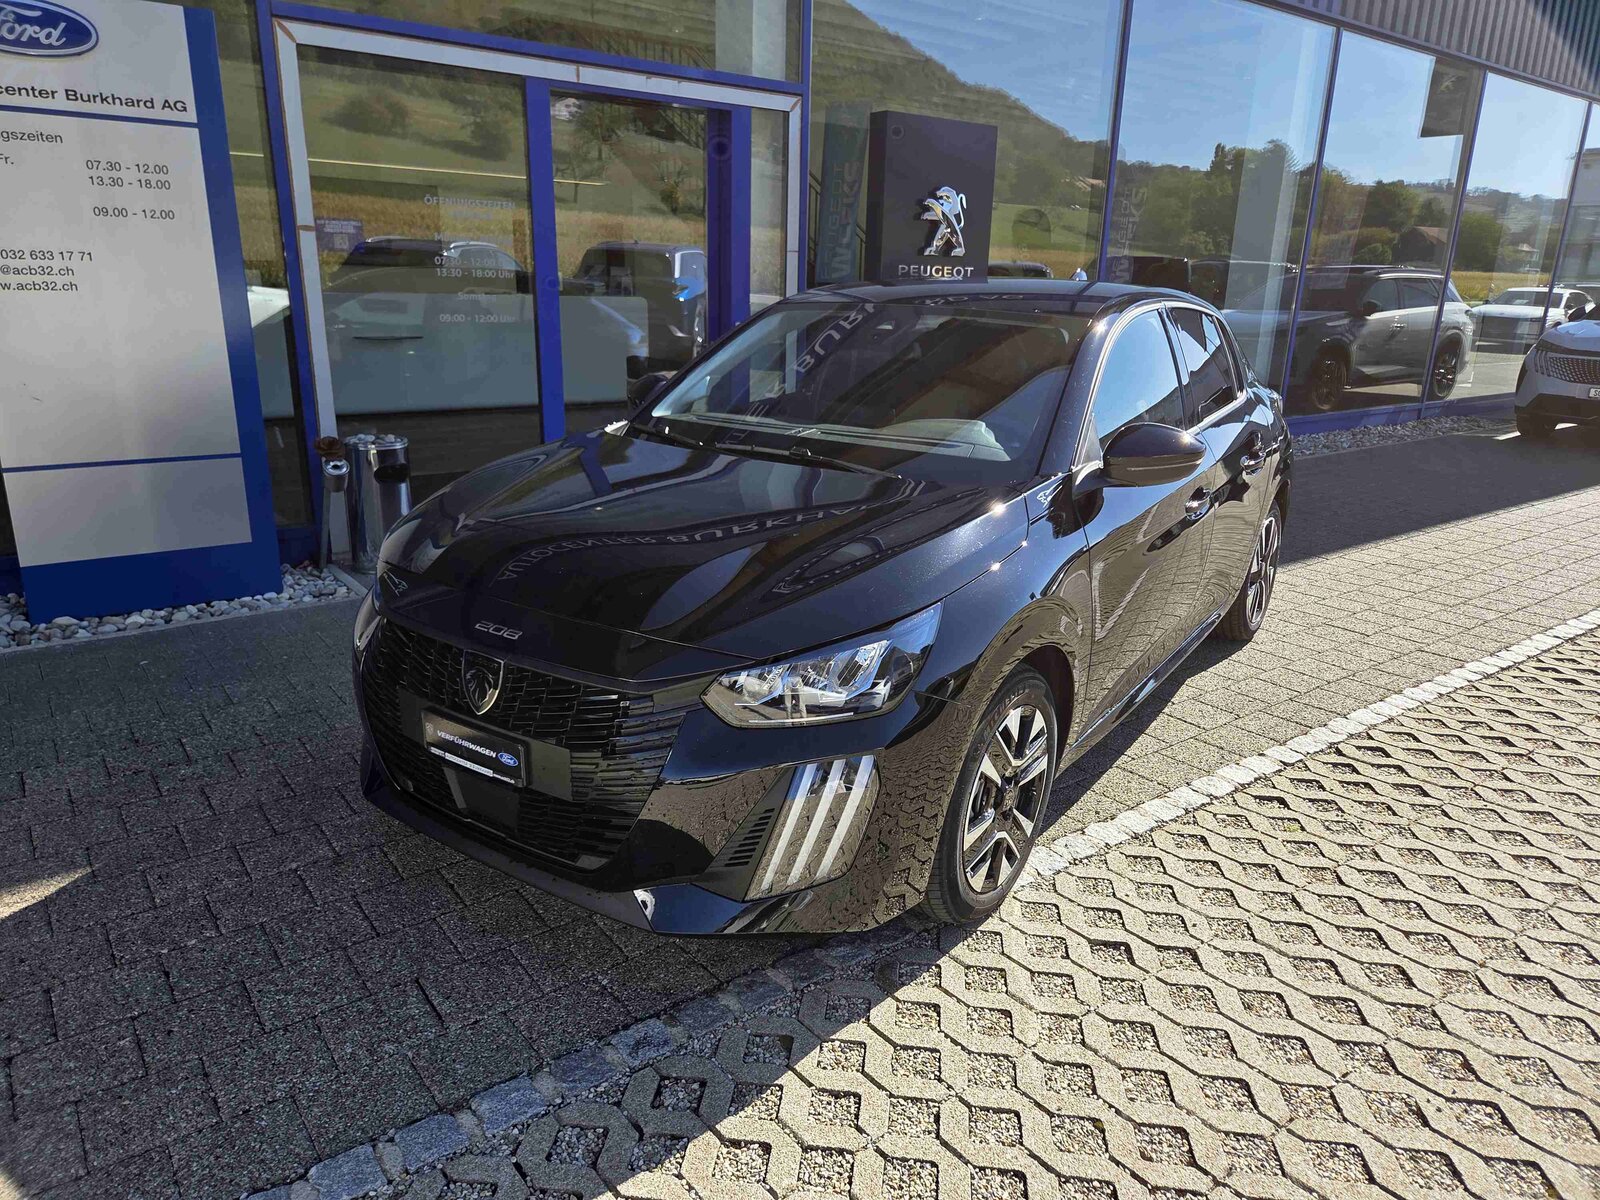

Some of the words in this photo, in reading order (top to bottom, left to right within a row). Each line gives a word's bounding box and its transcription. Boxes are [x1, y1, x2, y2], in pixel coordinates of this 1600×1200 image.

[0, 3, 68, 47] Ford
[64, 89, 155, 109] Burkhard
[161, 99, 188, 113] AG
[0, 130, 63, 144] gszeiten
[86, 160, 122, 172] 07.30
[135, 163, 169, 175] 12.00
[89, 176, 124, 188] 13.30
[137, 178, 171, 191] 18.00
[93, 206, 128, 218] 09.00
[141, 209, 175, 220] 12.00
[0, 249, 26, 260] 032
[30, 250, 54, 261] 633
[59, 251, 74, 261] 17
[78, 251, 93, 262] 71
[0, 264, 75, 277] @acb32.ch
[436, 268, 462, 278] 13:30
[472, 269, 497, 278] 18:00
[498, 270, 515, 279] Uhr
[897, 264, 974, 279] PEUGEOT
[440, 314, 466, 322] 09:00
[474, 314, 498, 323] 12:00
[474, 620, 523, 640] 208
[437, 730, 497, 758] VERFÜHRWAGEN
